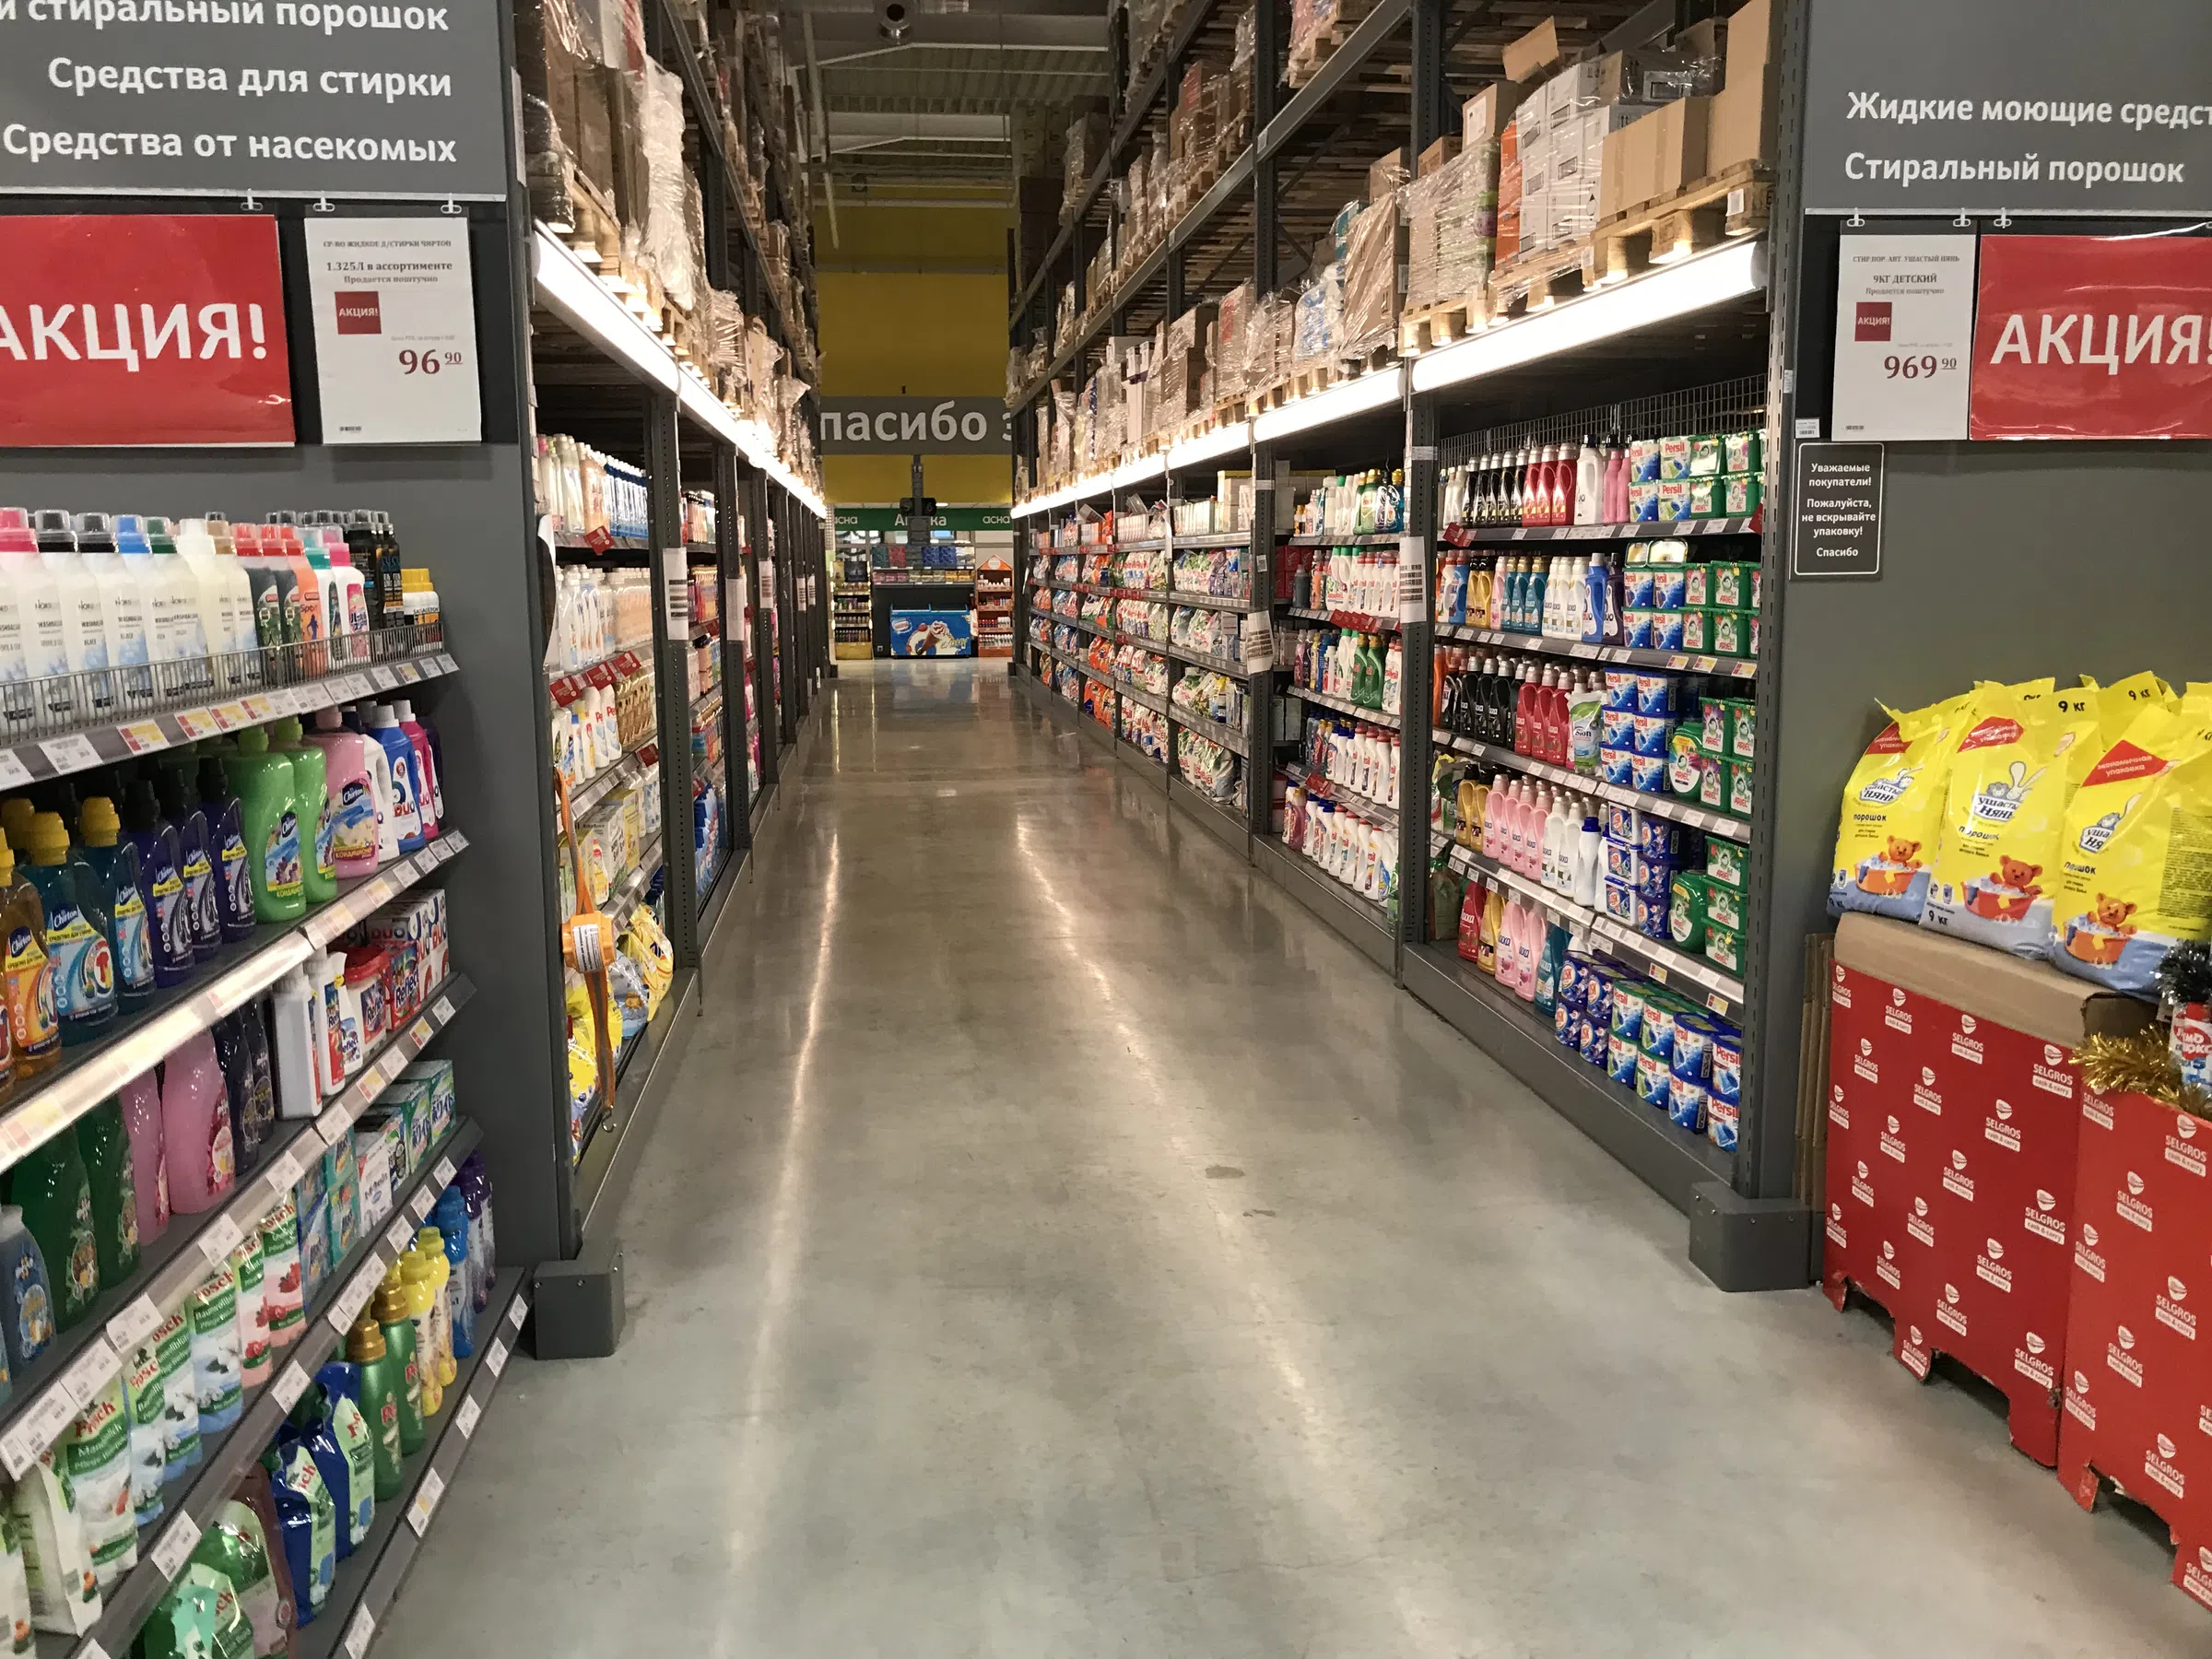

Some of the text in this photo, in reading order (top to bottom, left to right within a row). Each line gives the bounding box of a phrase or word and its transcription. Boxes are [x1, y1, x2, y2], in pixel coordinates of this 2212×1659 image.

[28, 0, 265, 30] стиральный
[276, 3, 449, 36] порошок
[48, 56, 452, 104] Средства для стирки
[1846, 91, 1973, 125] Жидкие
[1982, 100, 2112, 127] моющие
[3, 123, 457, 163] Средства от насекомых
[1845, 151, 2184, 189] Стиральный порошок
[376, 262, 453, 273] ассортименте
[1873, 273, 1937, 284] 9КГ ДЕТСКИЙ
[339, 307, 379, 318] АКЦИЯ!
[1857, 316, 1890, 326] АКЦИЯ!
[398, 348, 463, 375] 96 90
[1884, 355, 1958, 379] 969 90
[1665, 441, 1685, 453] Persil
[1811, 463, 1870, 473] Уважаемые
[1662, 482, 1683, 494] Persil
[1808, 477, 1872, 488] покупатели!
[1806, 498, 1872, 510] Пожалуйста,
[1816, 512, 1877, 524] вскрывайте
[1813, 526, 1863, 538] упаковку!
[1816, 547, 1859, 558] Спасибо
[1606, 673, 1622, 684] Persil
[2128, 689, 2136, 700] 9
[1605, 711, 1619, 722] Persil
[2058, 700, 2086, 712] 9 кг
[1602, 748, 1617, 760] Persil
[343, 787, 364, 805] Chirton
[1853, 813, 1888, 822] порошок
[53, 909, 78, 928] Chirton
[11, 934, 31, 955] Chirton
[1885, 1006, 1912, 1023] SELGROS
[1952, 1032, 1984, 1053] SELGROS
[1716, 1043, 1741, 1065] Persil
[2033, 1063, 2074, 1086] SELGROS
[1913, 1083, 1943, 1104] SELGROS
[1712, 1097, 1739, 1119] Persil
[2083, 1092, 2114, 1118] SELGROS
[1985, 1116, 2021, 1140] SELGROS
[2165, 1135, 2207, 1163] SELGROS
[1943, 1166, 1975, 1190] SELGROS
[2117, 1190, 2153, 1219] SELGROS
[1907, 1212, 1935, 1236] SELGROS
[2024, 1206, 2066, 1232] SELGROS
[1976, 1253, 2013, 1281] SELGROS
[1936, 1298, 1968, 1325] SELGROS
[2156, 1293, 2197, 1327] SELGROS
[2015, 1347, 2054, 1376] SELGROS
[2108, 1342, 2144, 1375] SELGROS
[2146, 1449, 2185, 1486] SELGROS
